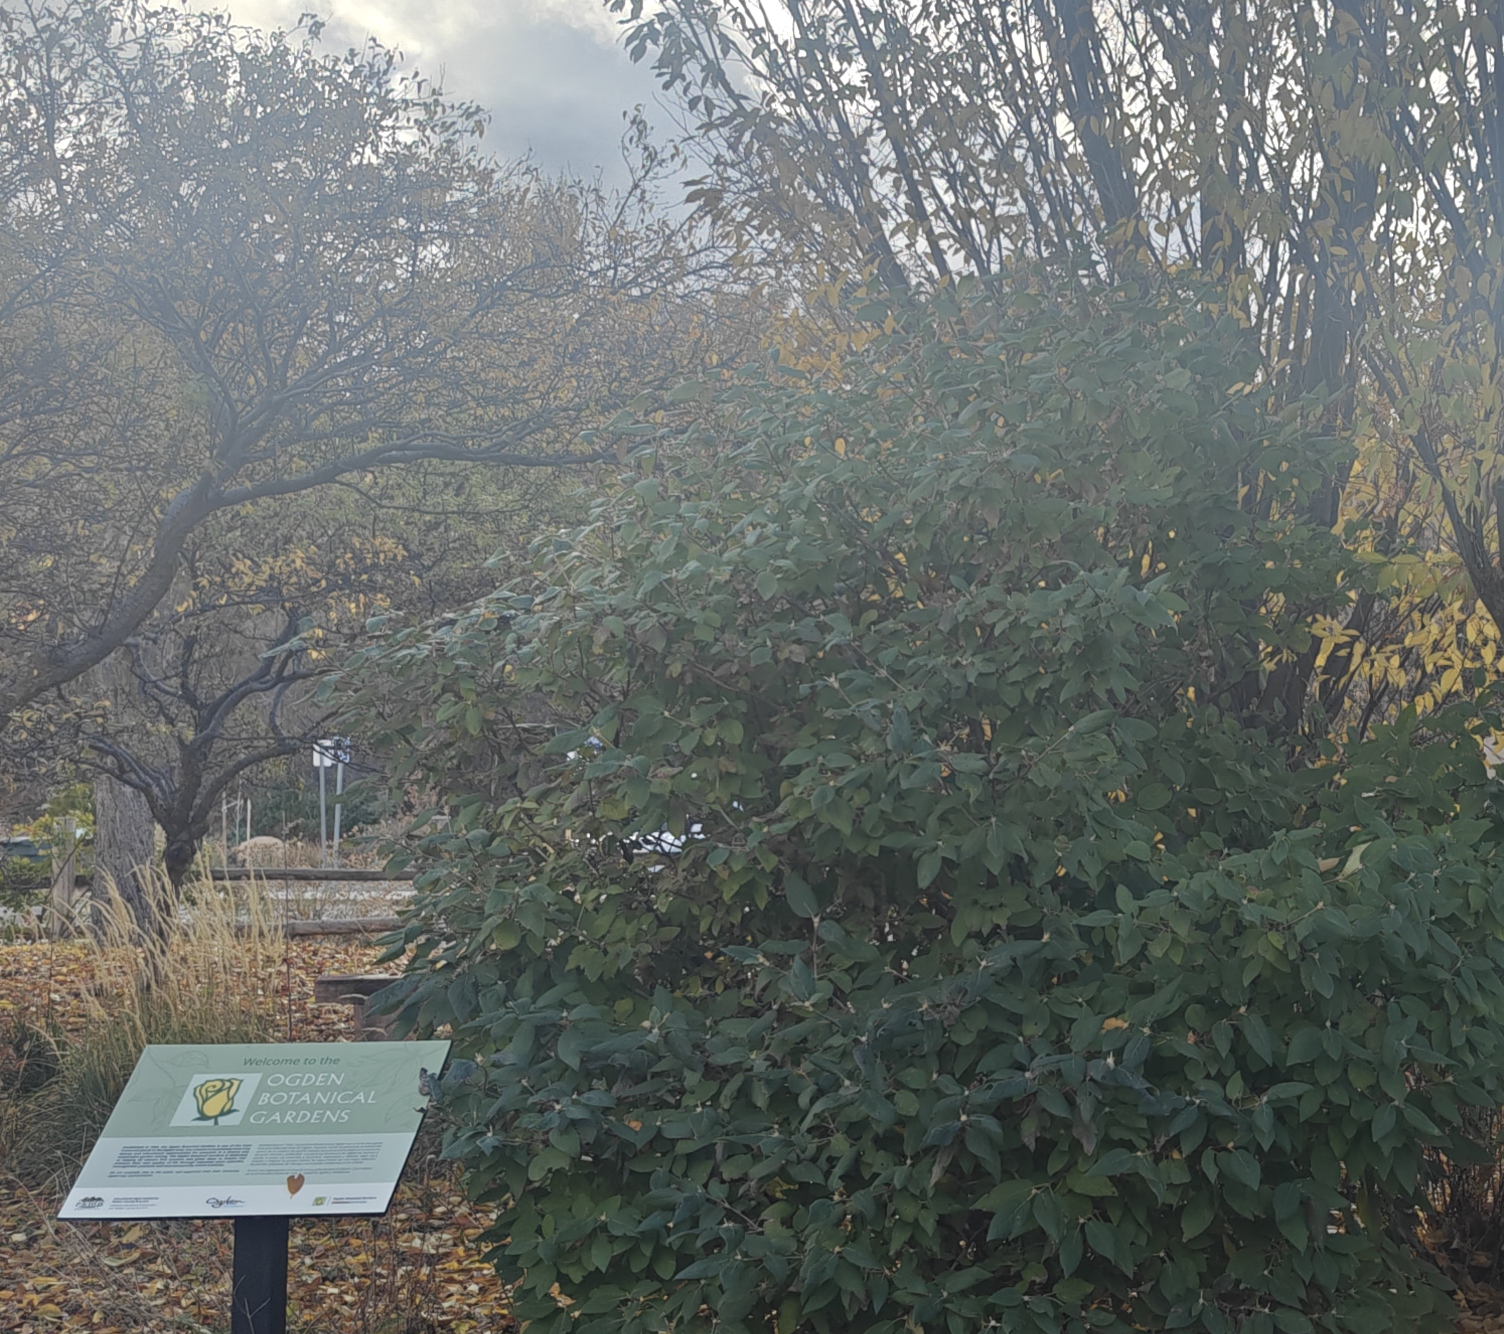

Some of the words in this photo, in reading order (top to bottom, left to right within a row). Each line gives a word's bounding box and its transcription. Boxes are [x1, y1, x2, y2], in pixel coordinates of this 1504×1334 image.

[243, 1057, 301, 1066] Welcome
[303, 1057, 317, 1065] to
[319, 1056, 341, 1065] the
[267, 1072, 345, 1087] OGDEN
[257, 1090, 378, 1106] BOTANICAL
[249, 1109, 351, 1124] GARDENS
